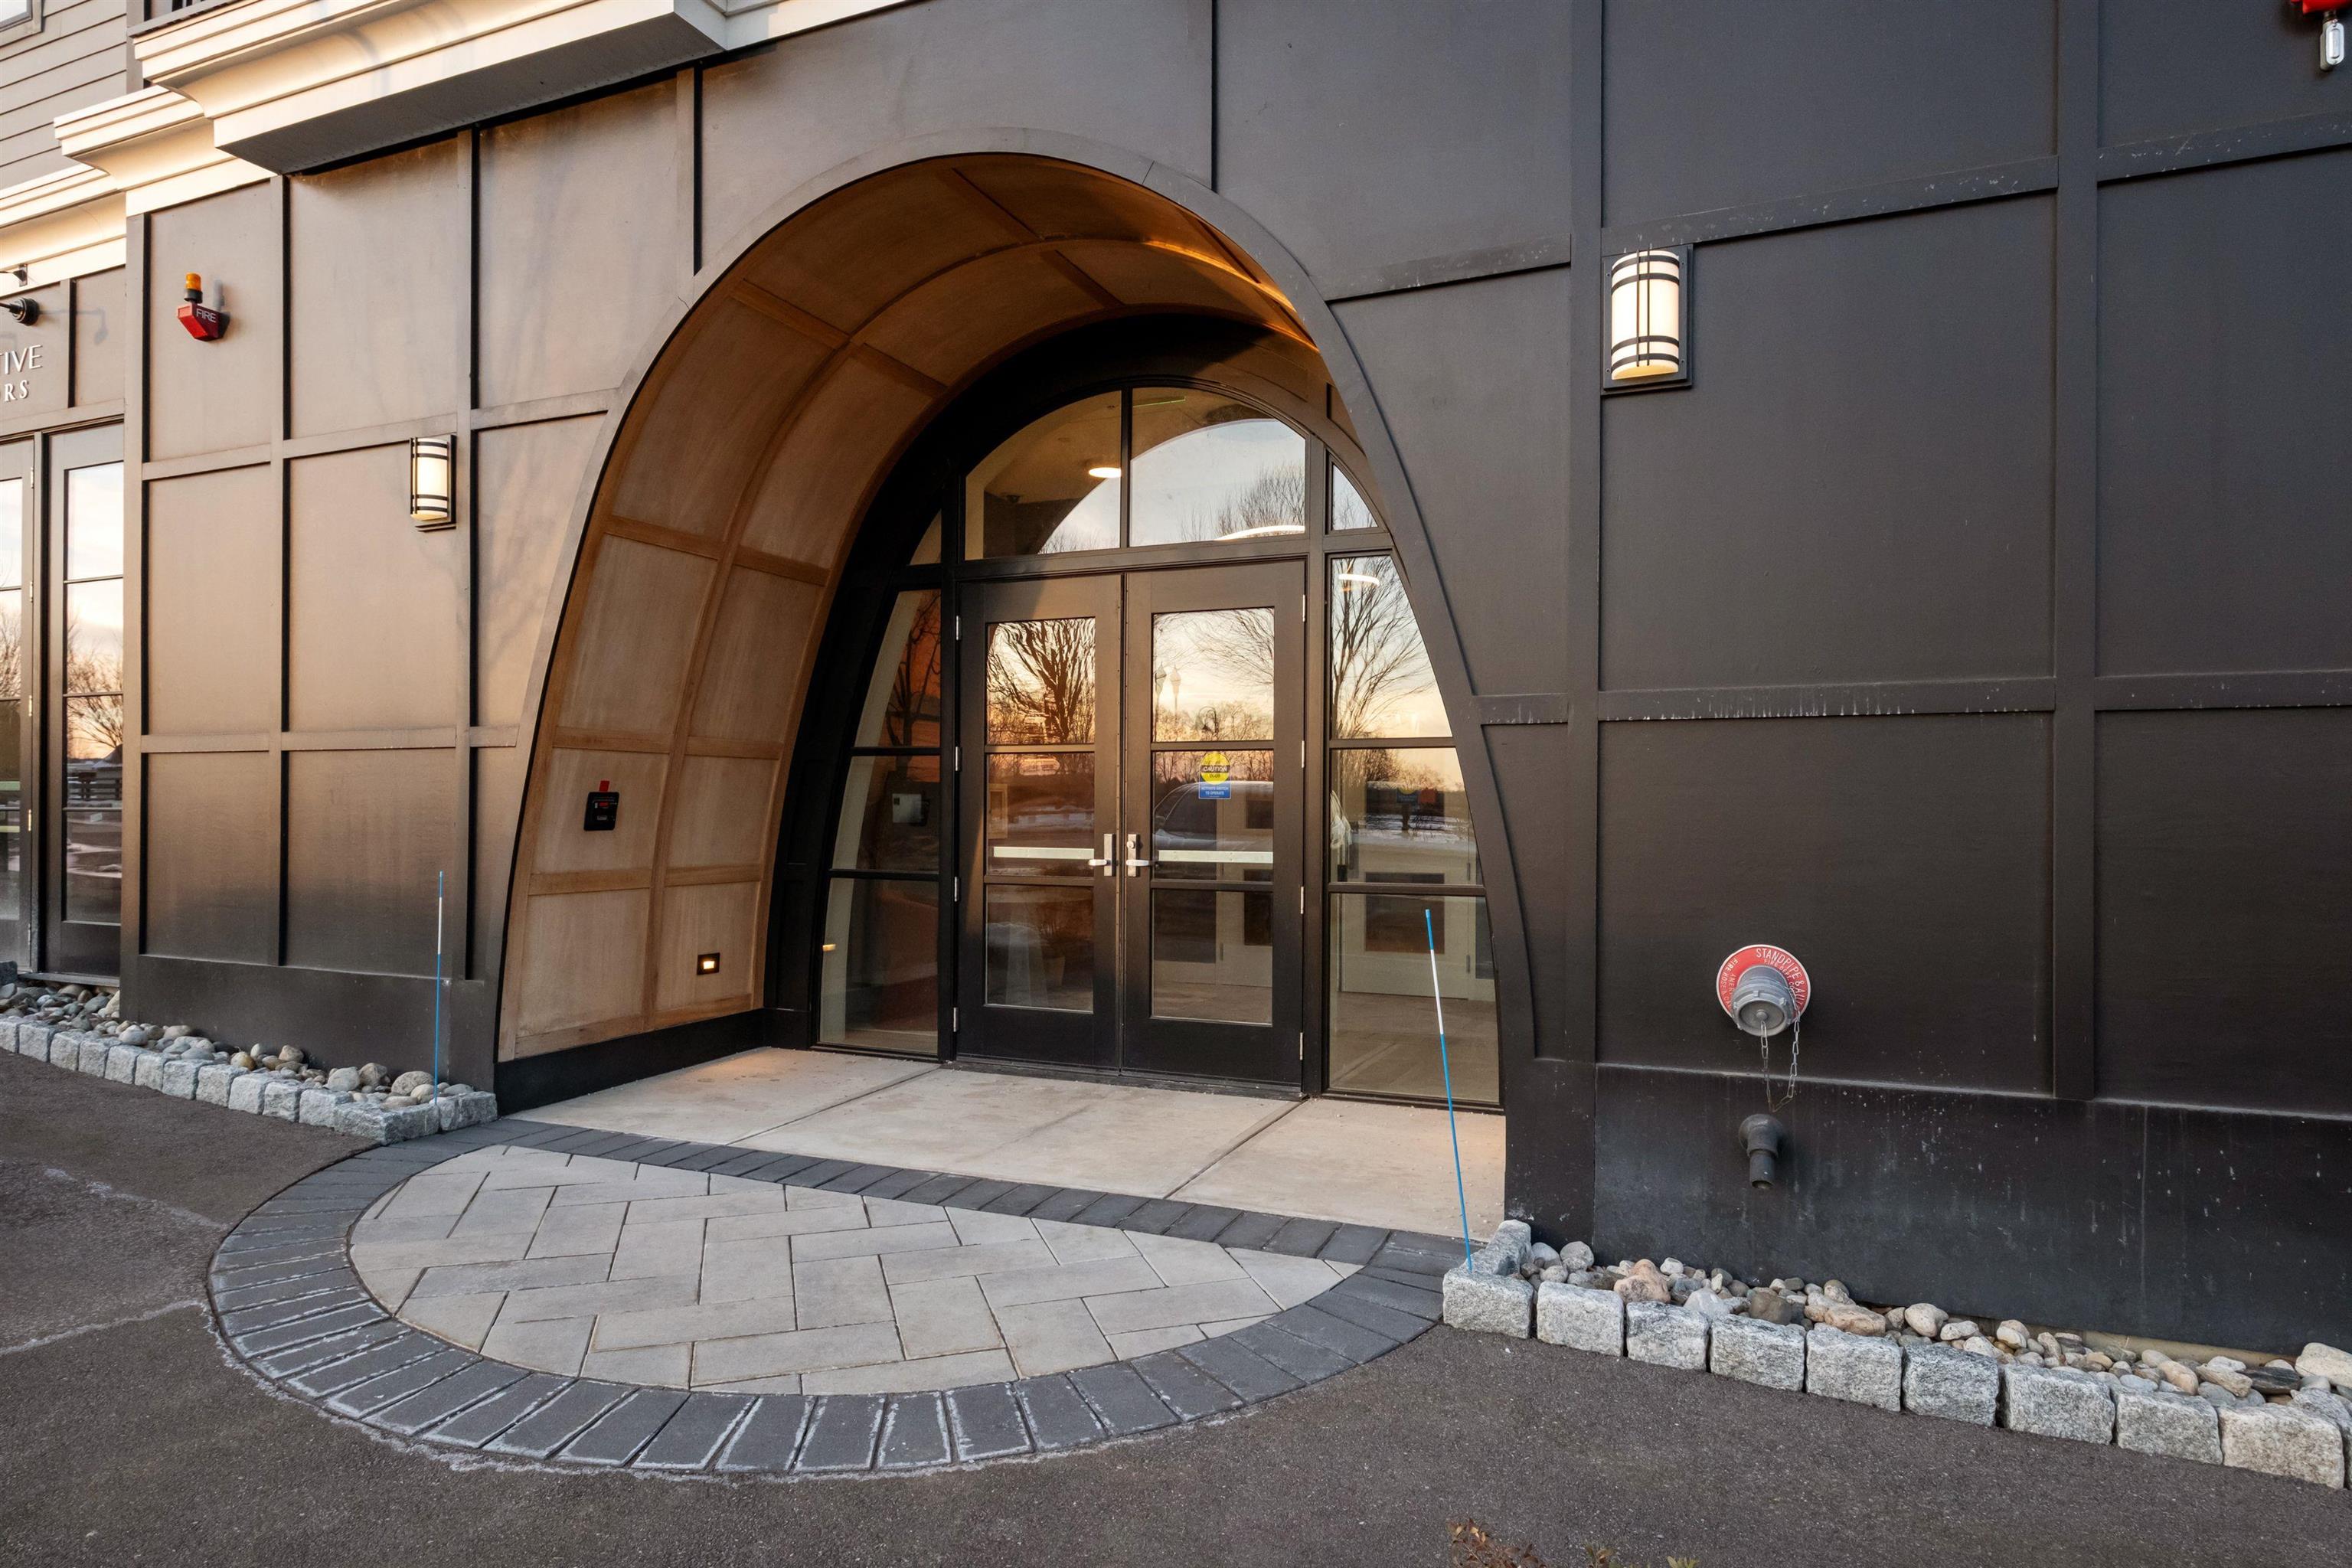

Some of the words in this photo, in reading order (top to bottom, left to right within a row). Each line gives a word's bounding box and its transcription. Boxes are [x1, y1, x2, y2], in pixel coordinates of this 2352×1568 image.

[196, 309, 217, 323] FIRE
[0, 345, 42, 374] IVE
[0, 380, 29, 402] RS
[1725, 958, 1739, 972] FIRE
[1763, 959, 1778, 967] FIRE
[1756, 948, 1803, 979] STANDPIPE
[1795, 988, 1806, 1006] AUT
